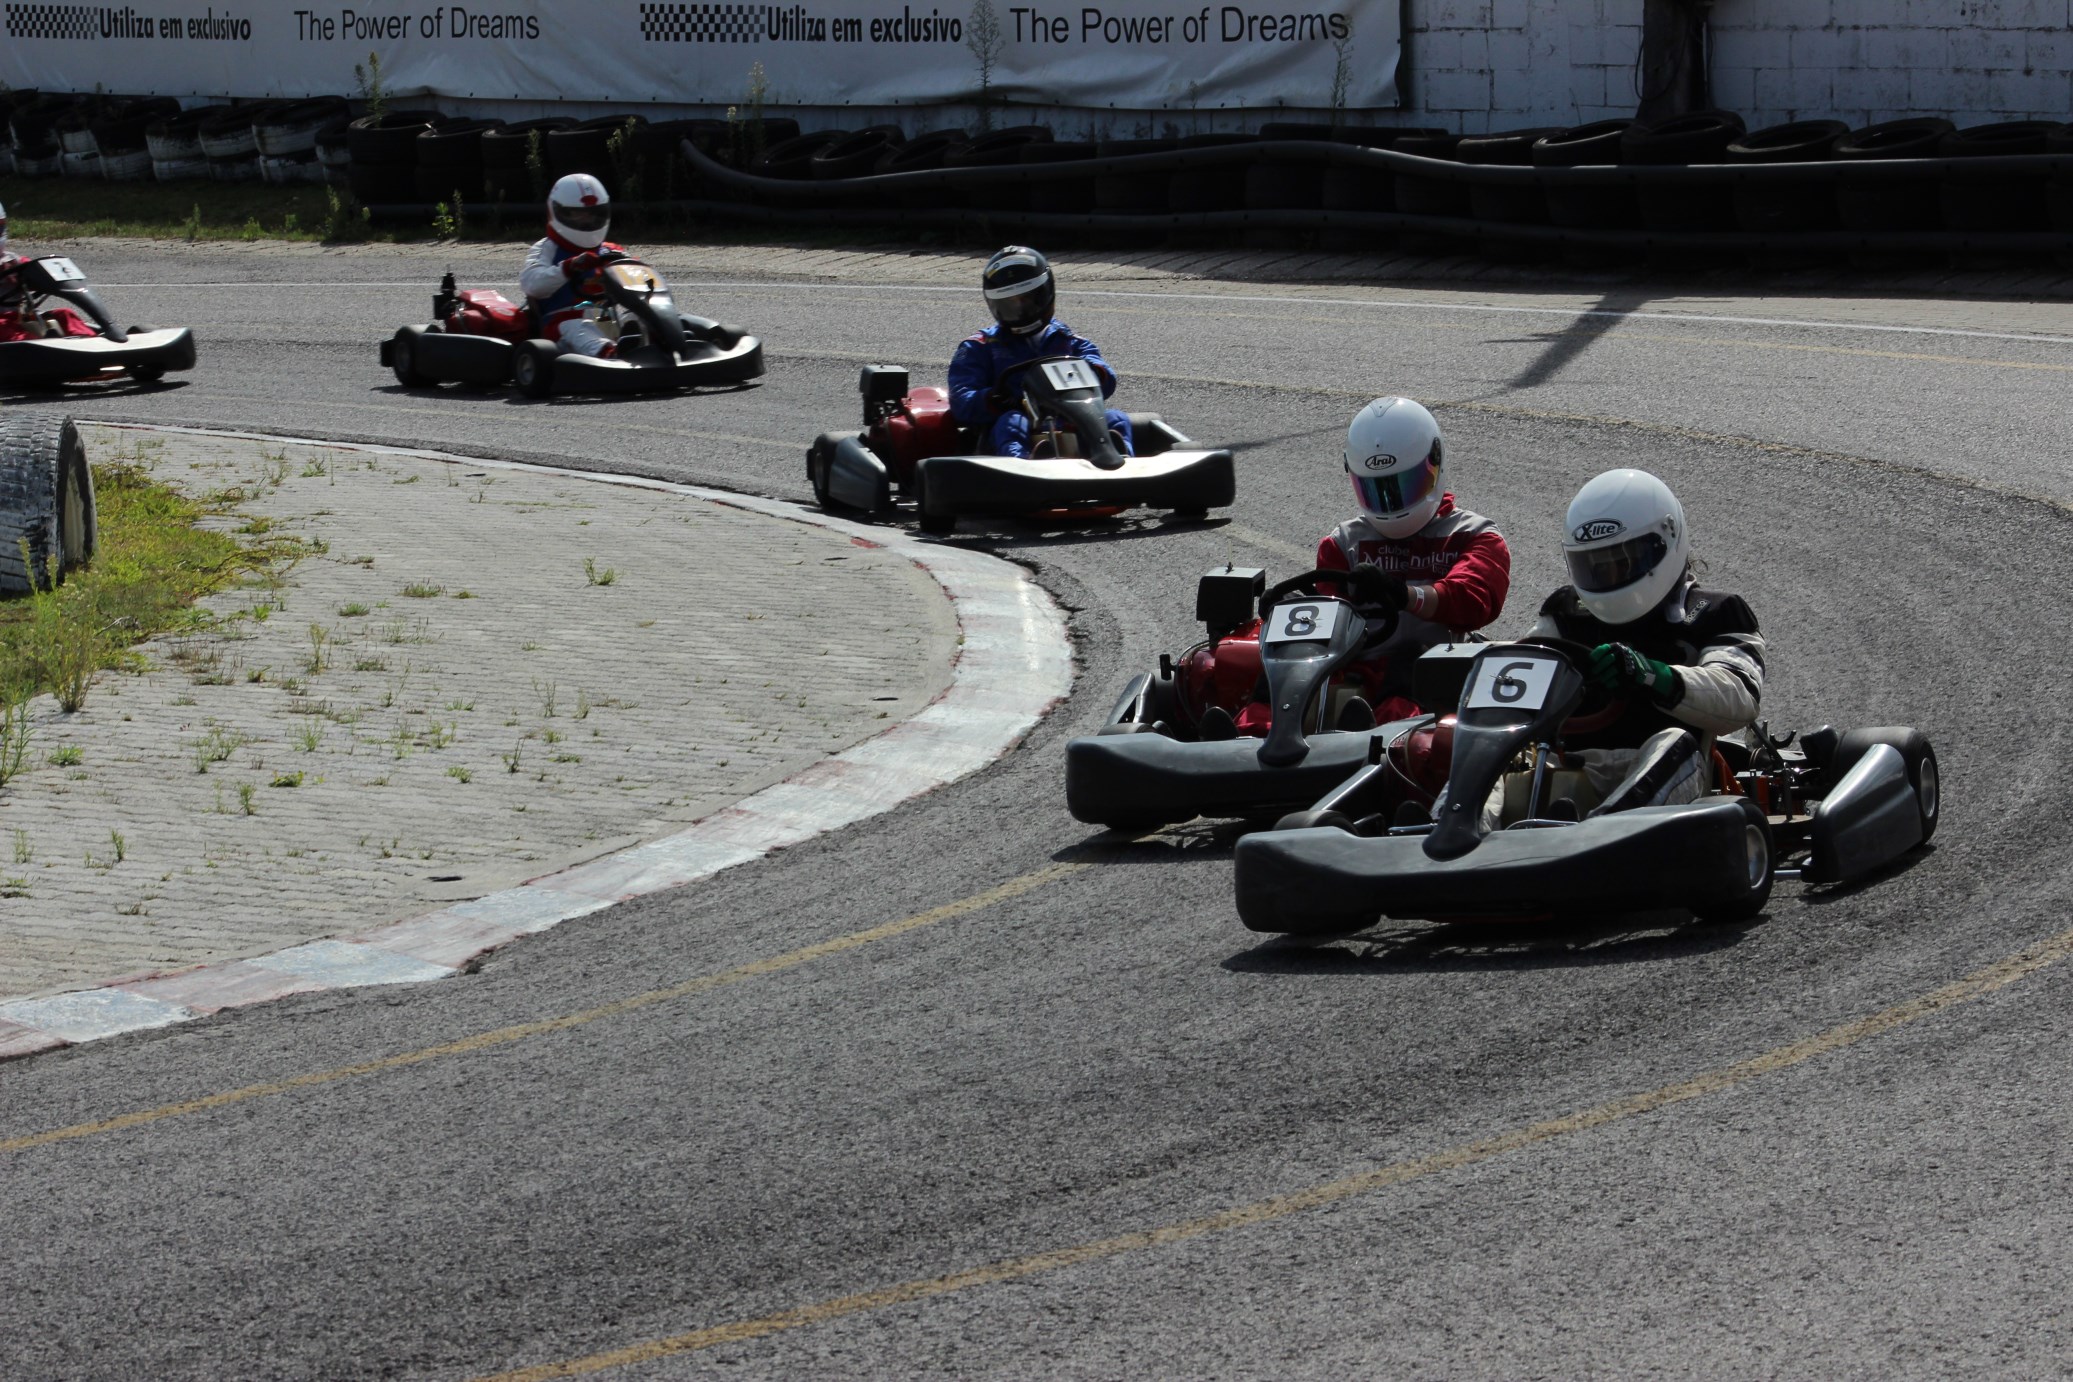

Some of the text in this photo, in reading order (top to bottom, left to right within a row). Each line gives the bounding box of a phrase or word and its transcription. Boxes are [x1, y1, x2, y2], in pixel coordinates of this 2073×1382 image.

[99, 6, 252, 41] Utiliza em exclusivo
[293, 6, 540, 41] The Power of Dreams
[767, 4, 964, 43] Utiliza em exclusivo
[1009, 5, 1349, 44] The Power of Dreams
[1367, 455, 1392, 467] Arai
[1378, 545, 1409, 556] clube
[1284, 605, 1320, 637] 8
[1490, 661, 1535, 704] 6
